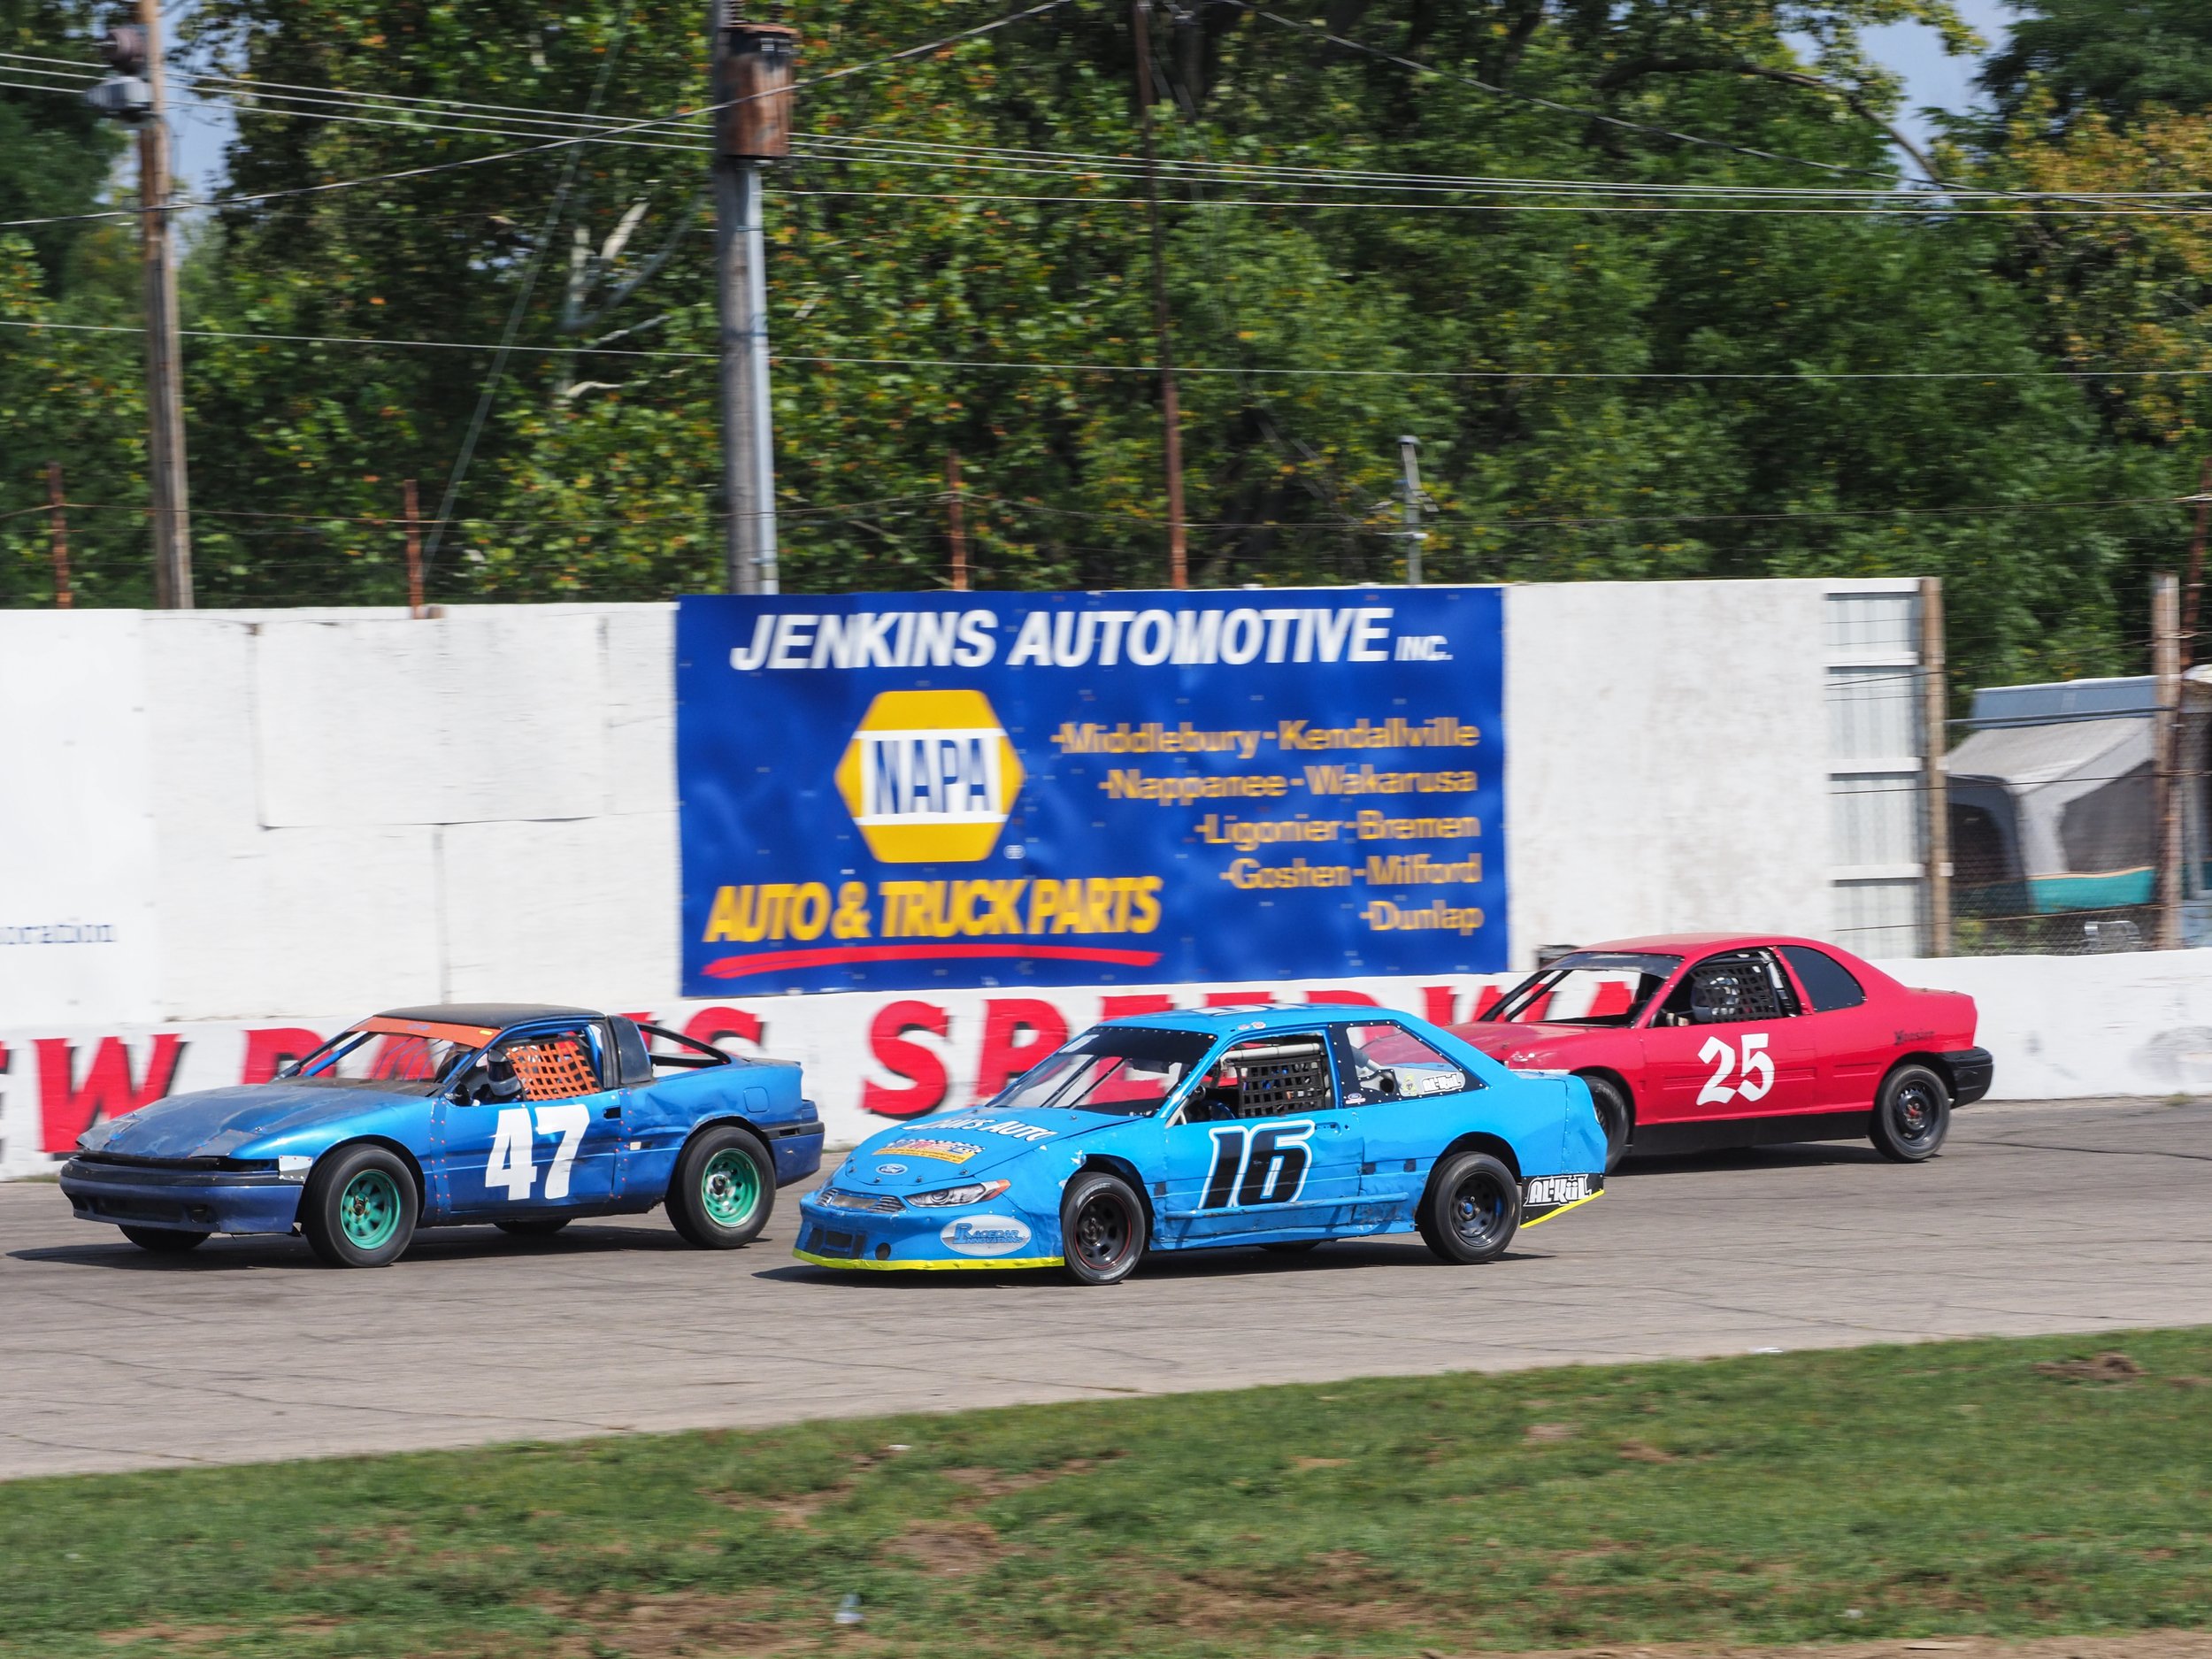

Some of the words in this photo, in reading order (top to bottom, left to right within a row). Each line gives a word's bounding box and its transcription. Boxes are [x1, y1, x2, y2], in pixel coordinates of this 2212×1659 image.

[730, 610, 997, 671] JENKINS
[1006, 608, 1394, 667] AUTOMOTIVE
[874, 738, 991, 814] NAPA
[703, 882, 832, 942] AUTO
[831, 881, 872, 939] &
[879, 879, 1027, 938] TRUCK
[1028, 876, 1163, 934] PARTS
[1696, 1033, 1775, 1106] 25
[485, 1104, 590, 1202] 47
[978, 1120, 1059, 1142] AUTO
[1198, 1119, 1316, 1209] 16
